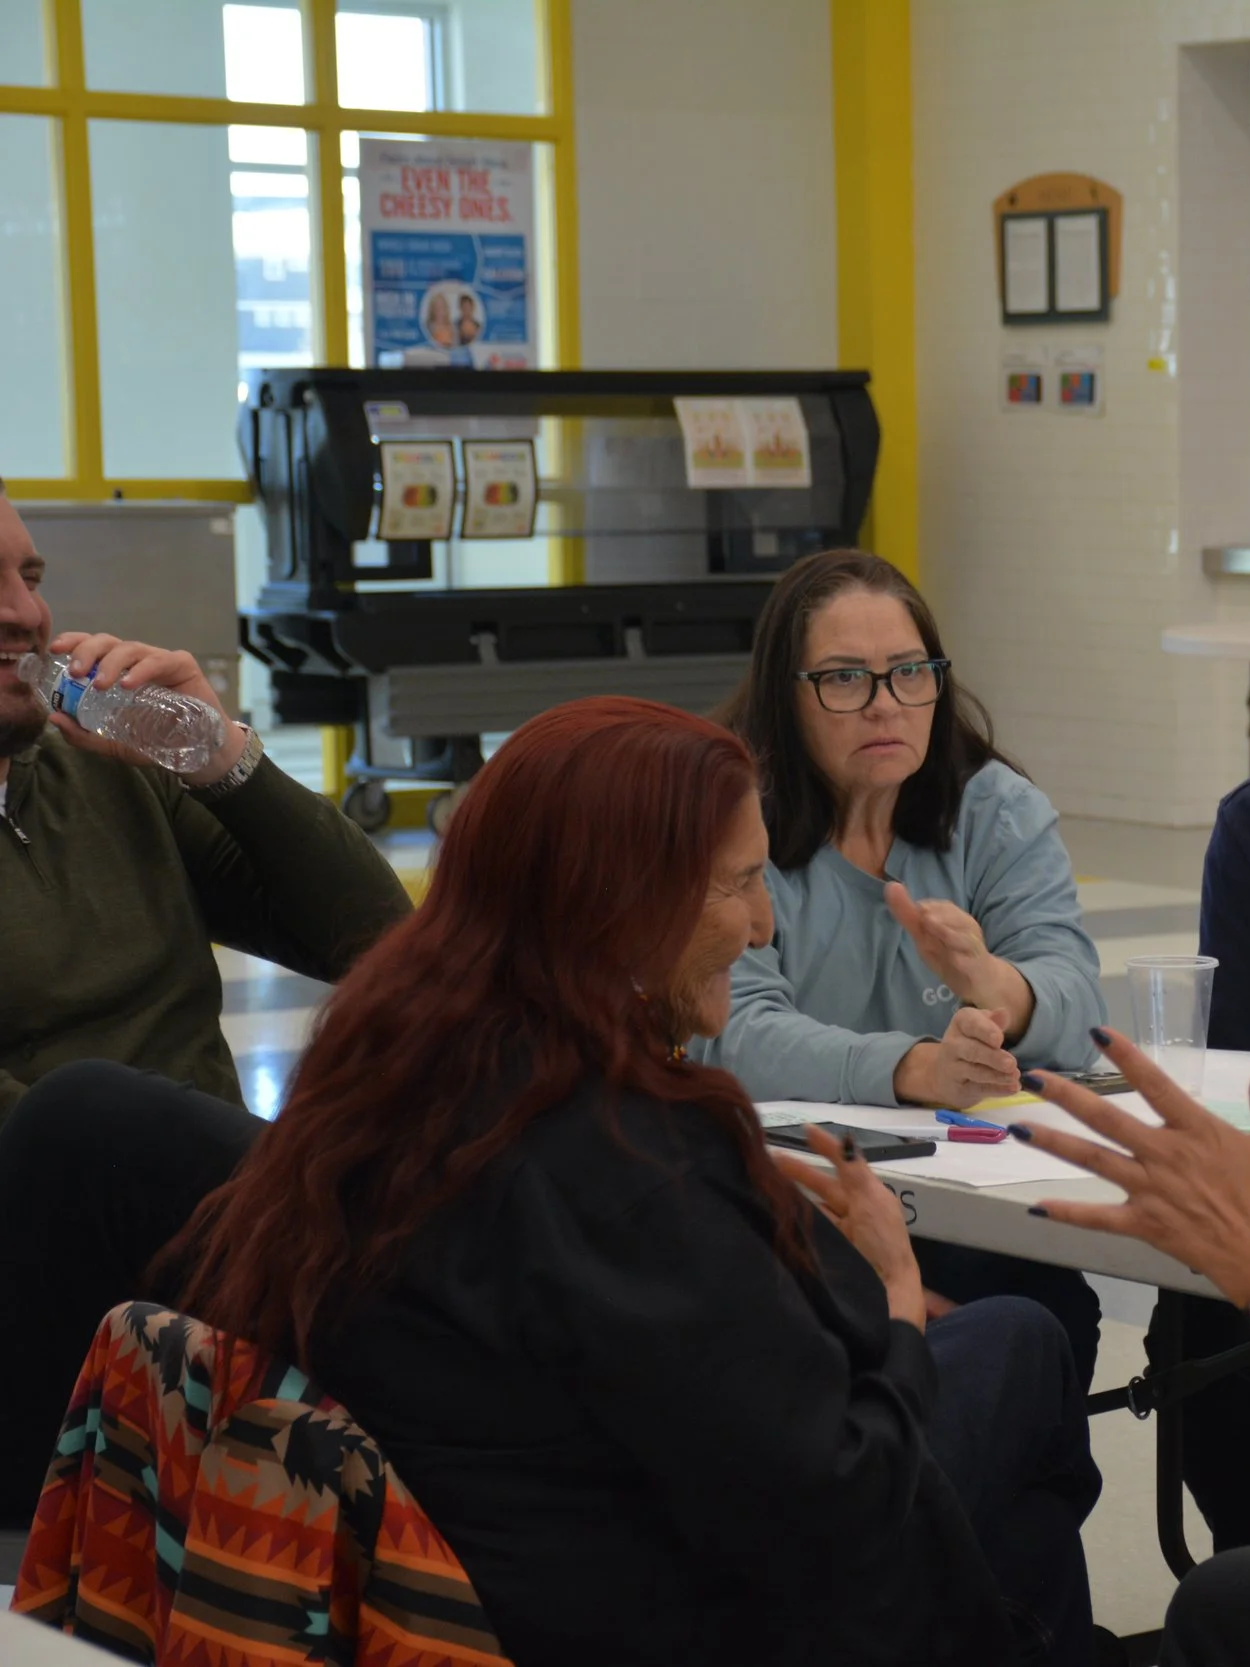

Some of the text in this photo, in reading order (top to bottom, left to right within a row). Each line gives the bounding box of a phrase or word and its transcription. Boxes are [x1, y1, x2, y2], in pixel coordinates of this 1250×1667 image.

[401, 167, 491, 195] EVEN THE
[380, 193, 453, 220] CHEESY
